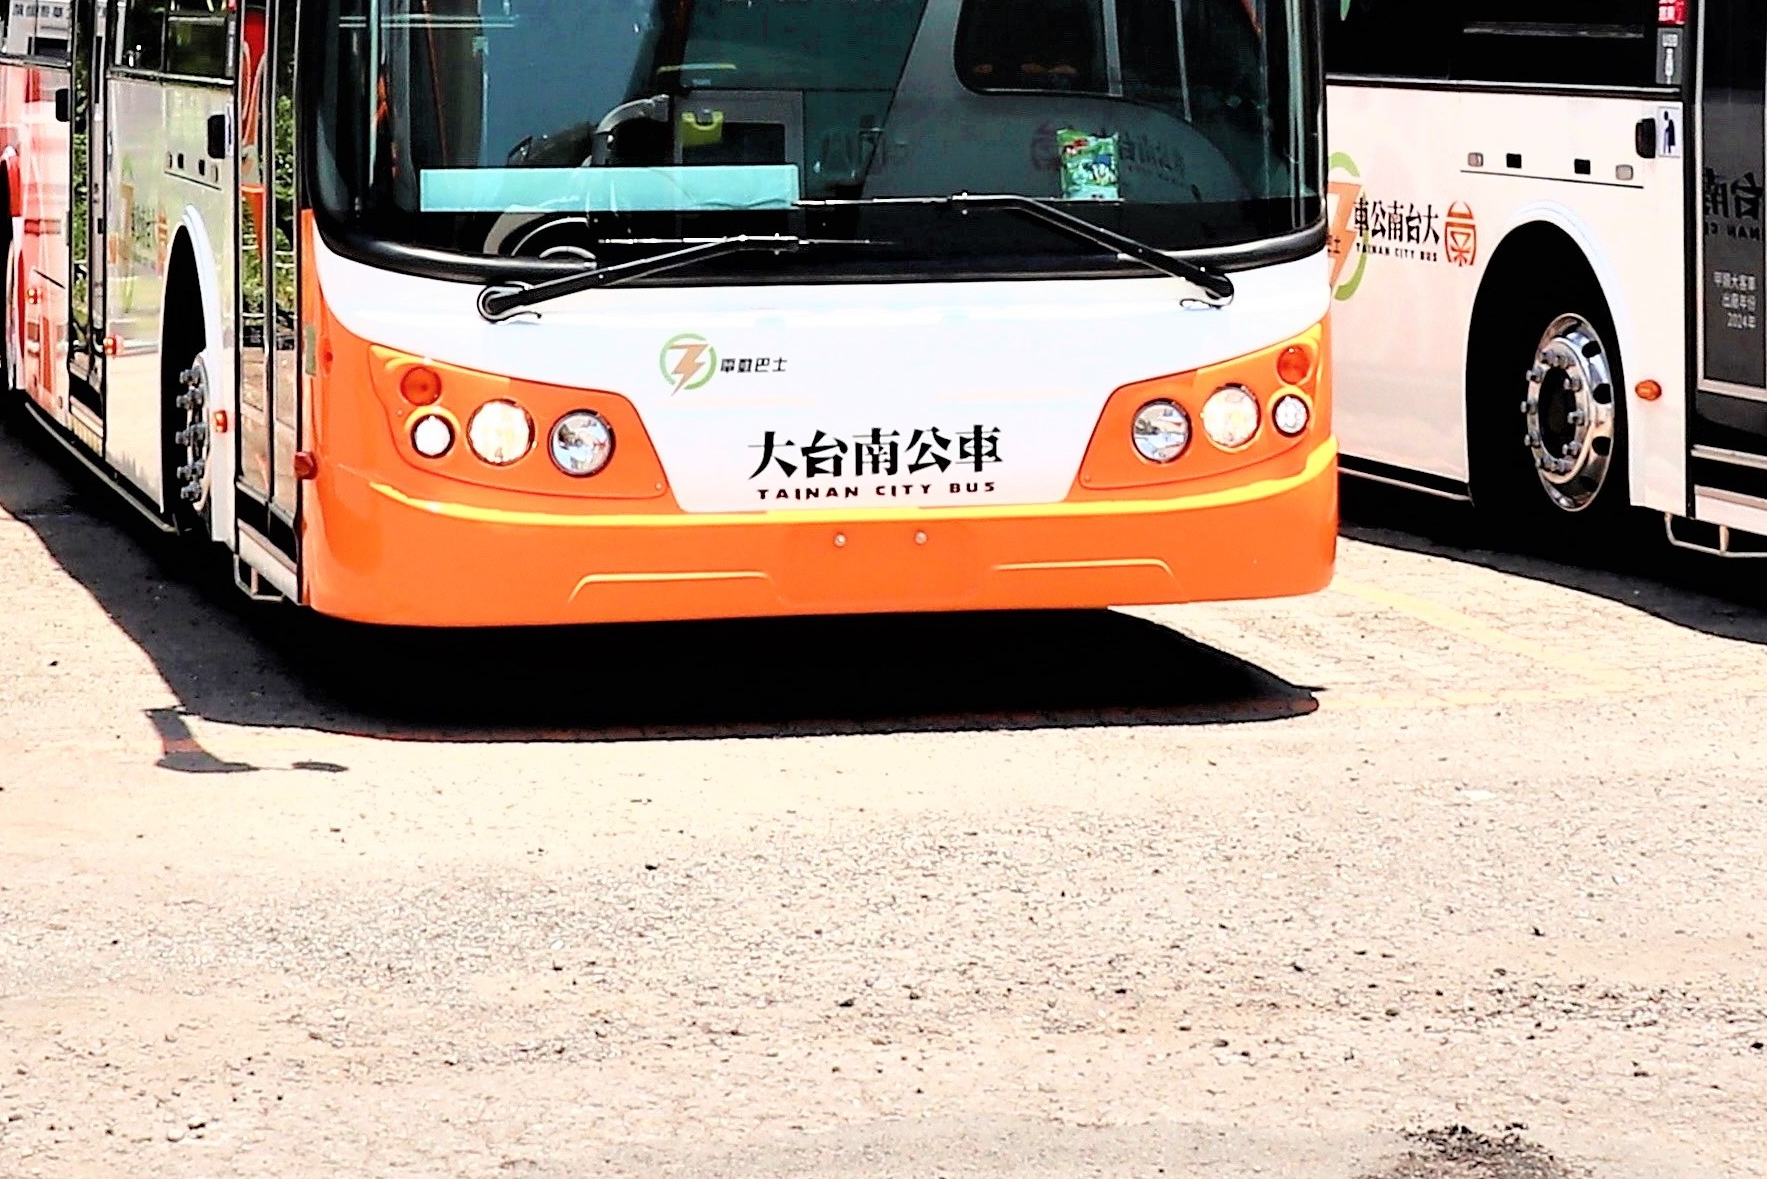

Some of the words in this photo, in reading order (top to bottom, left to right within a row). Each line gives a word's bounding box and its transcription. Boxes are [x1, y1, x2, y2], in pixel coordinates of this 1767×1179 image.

[748, 424, 1003, 481] 大台南公車
[757, 486, 859, 500] TAINAN
[875, 483, 932, 497] CITY
[949, 482, 996, 494] BUS
